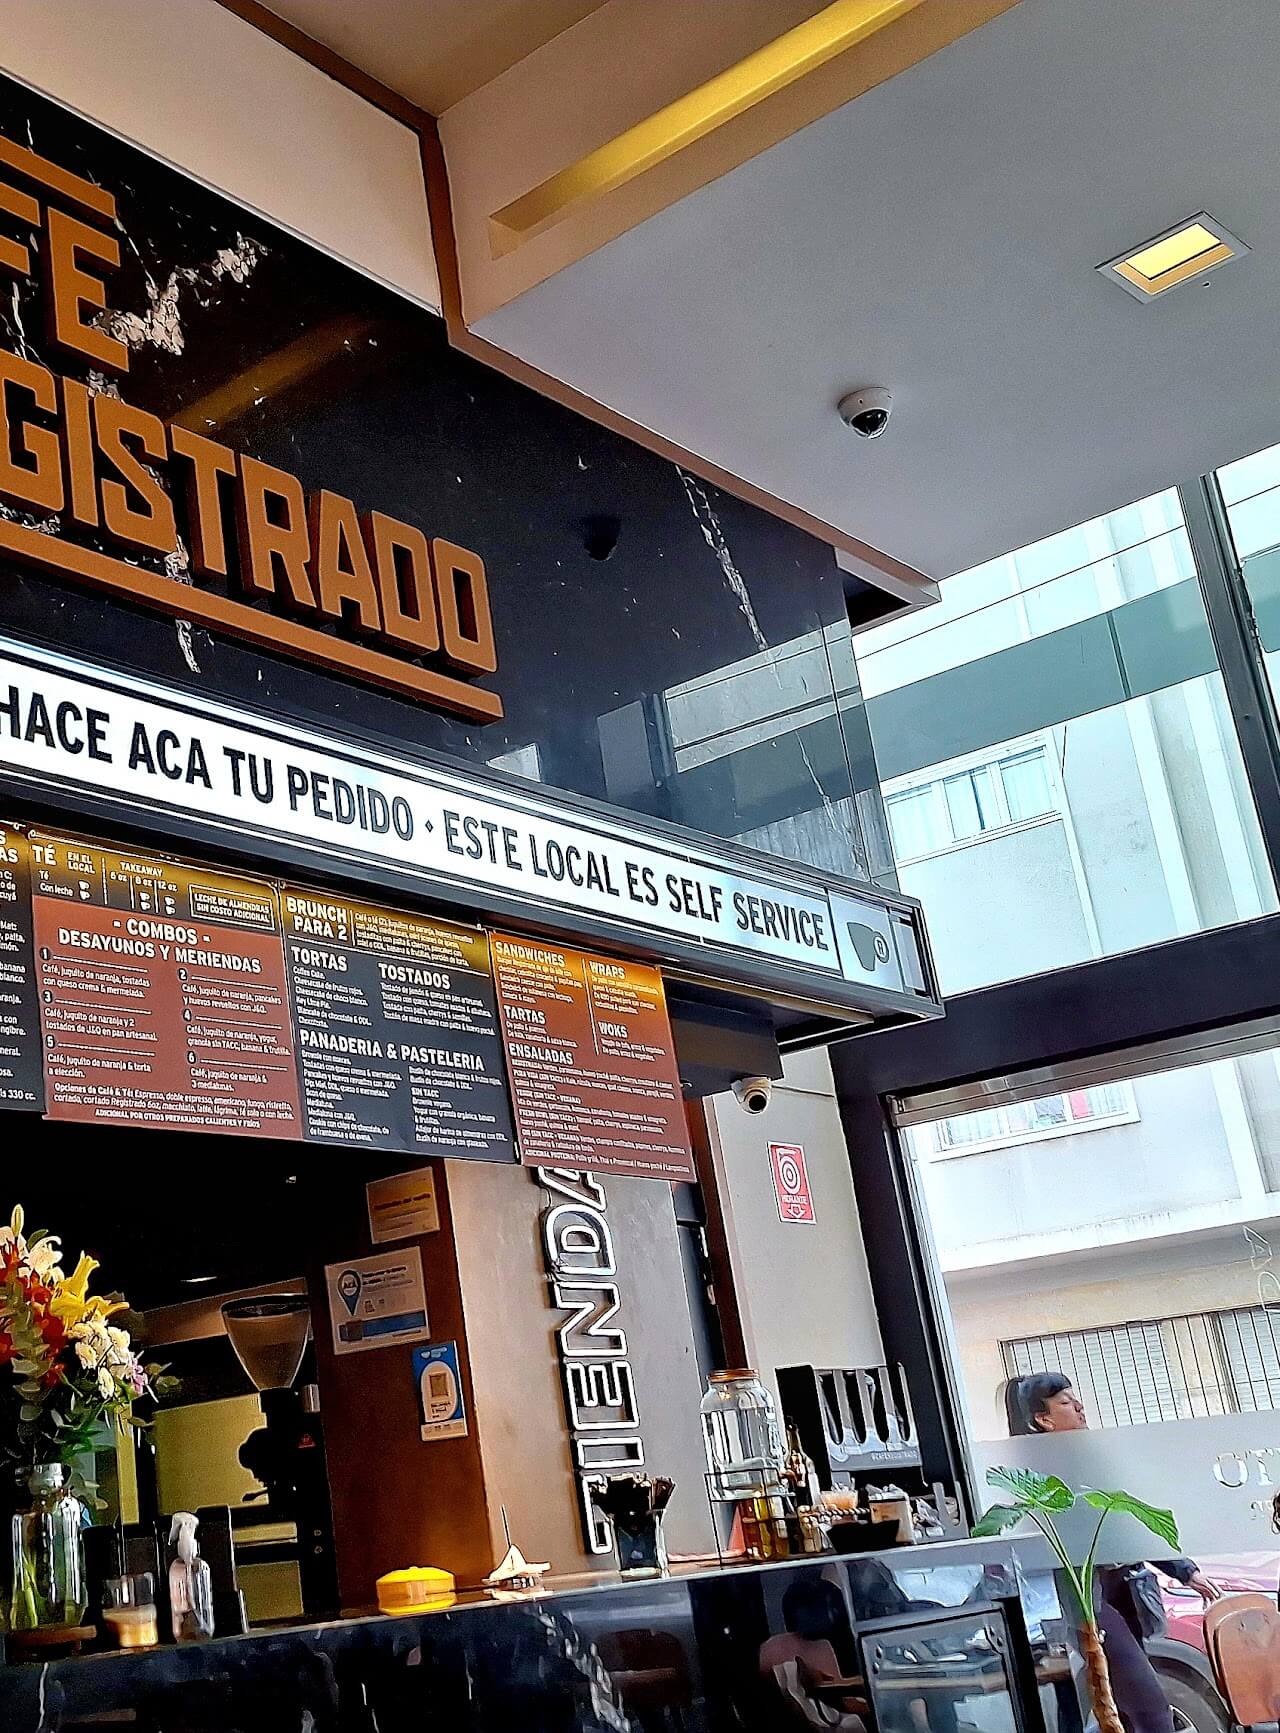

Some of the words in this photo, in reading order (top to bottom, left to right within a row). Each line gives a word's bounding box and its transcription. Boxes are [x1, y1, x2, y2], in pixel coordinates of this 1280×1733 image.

[129, 722, 212, 790] ACA
[223, 747, 273, 805] TU
[287, 766, 413, 841] PEDIDO
[446, 810, 522, 871] ESTE
[531, 832, 619, 896] LOCAL
[625, 861, 658, 906] ES
[667, 873, 723, 924] SELF
[732, 894, 829, 951] SERVICE
[31, 844, 57, 867] TÉ
[67, 851, 79, 862] EN
[80, 853, 93, 864] EL
[67, 860, 96, 875] LOCAL
[120, 861, 163, 877] TAKEAWAY
[6, 880, 16, 891] de
[39, 882, 54, 893] Con
[54, 884, 74, 897] leche
[194, 893, 217, 906] LECHE
[286, 896, 347, 924] BRUNCH
[196, 903, 208, 914] SIN
[209, 905, 232, 917] COSTO
[233, 909, 270, 923] ADICIONAL
[127, 918, 198, 945] COMBOS
[293, 915, 334, 938] PARA
[337, 924, 348, 940] 2
[59, 927, 155, 959] DESAYUNOS
[159, 942, 170, 960] Y
[175, 948, 262, 974] MERIENDAS
[290, 946, 348, 972] TORTAS
[495, 941, 565, 967] SANDWICHES
[378, 962, 451, 990] TOSTADOS
[589, 960, 626, 980] WRAPS
[3, 1014, 18, 1024] con
[503, 1004, 546, 1025] TARTAS
[598, 1021, 628, 1038] WOKS
[300, 1029, 383, 1058] PANADERIA
[387, 1043, 398, 1060] &
[400, 1045, 485, 1072] PASTELERIA
[509, 1042, 574, 1065] ENSALADAS
[7, 1089, 24, 1100] 330
